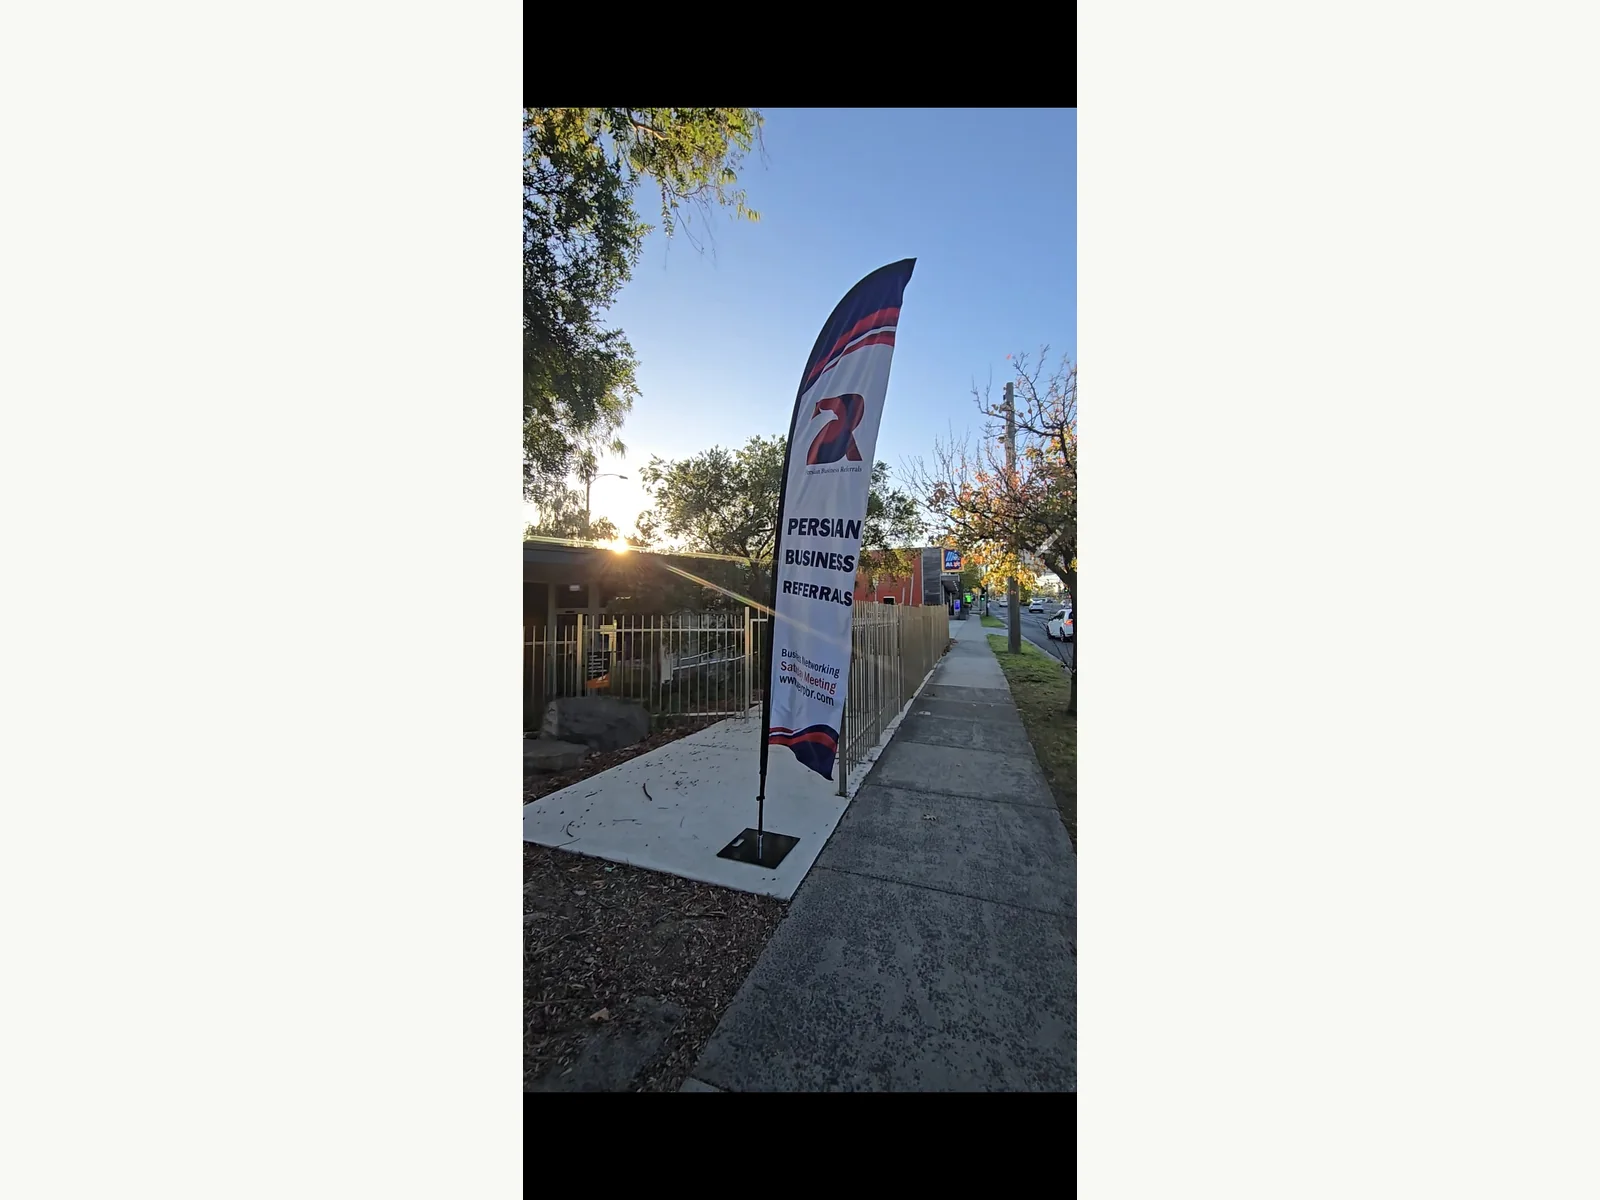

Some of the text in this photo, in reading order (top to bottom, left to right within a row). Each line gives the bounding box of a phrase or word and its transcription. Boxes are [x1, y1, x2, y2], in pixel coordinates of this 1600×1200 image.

[787, 517, 861, 540] PERSIAN
[785, 549, 856, 573] BUSINESS
[782, 580, 853, 607] REFERRALS
[804, 671, 838, 695] Meeting
